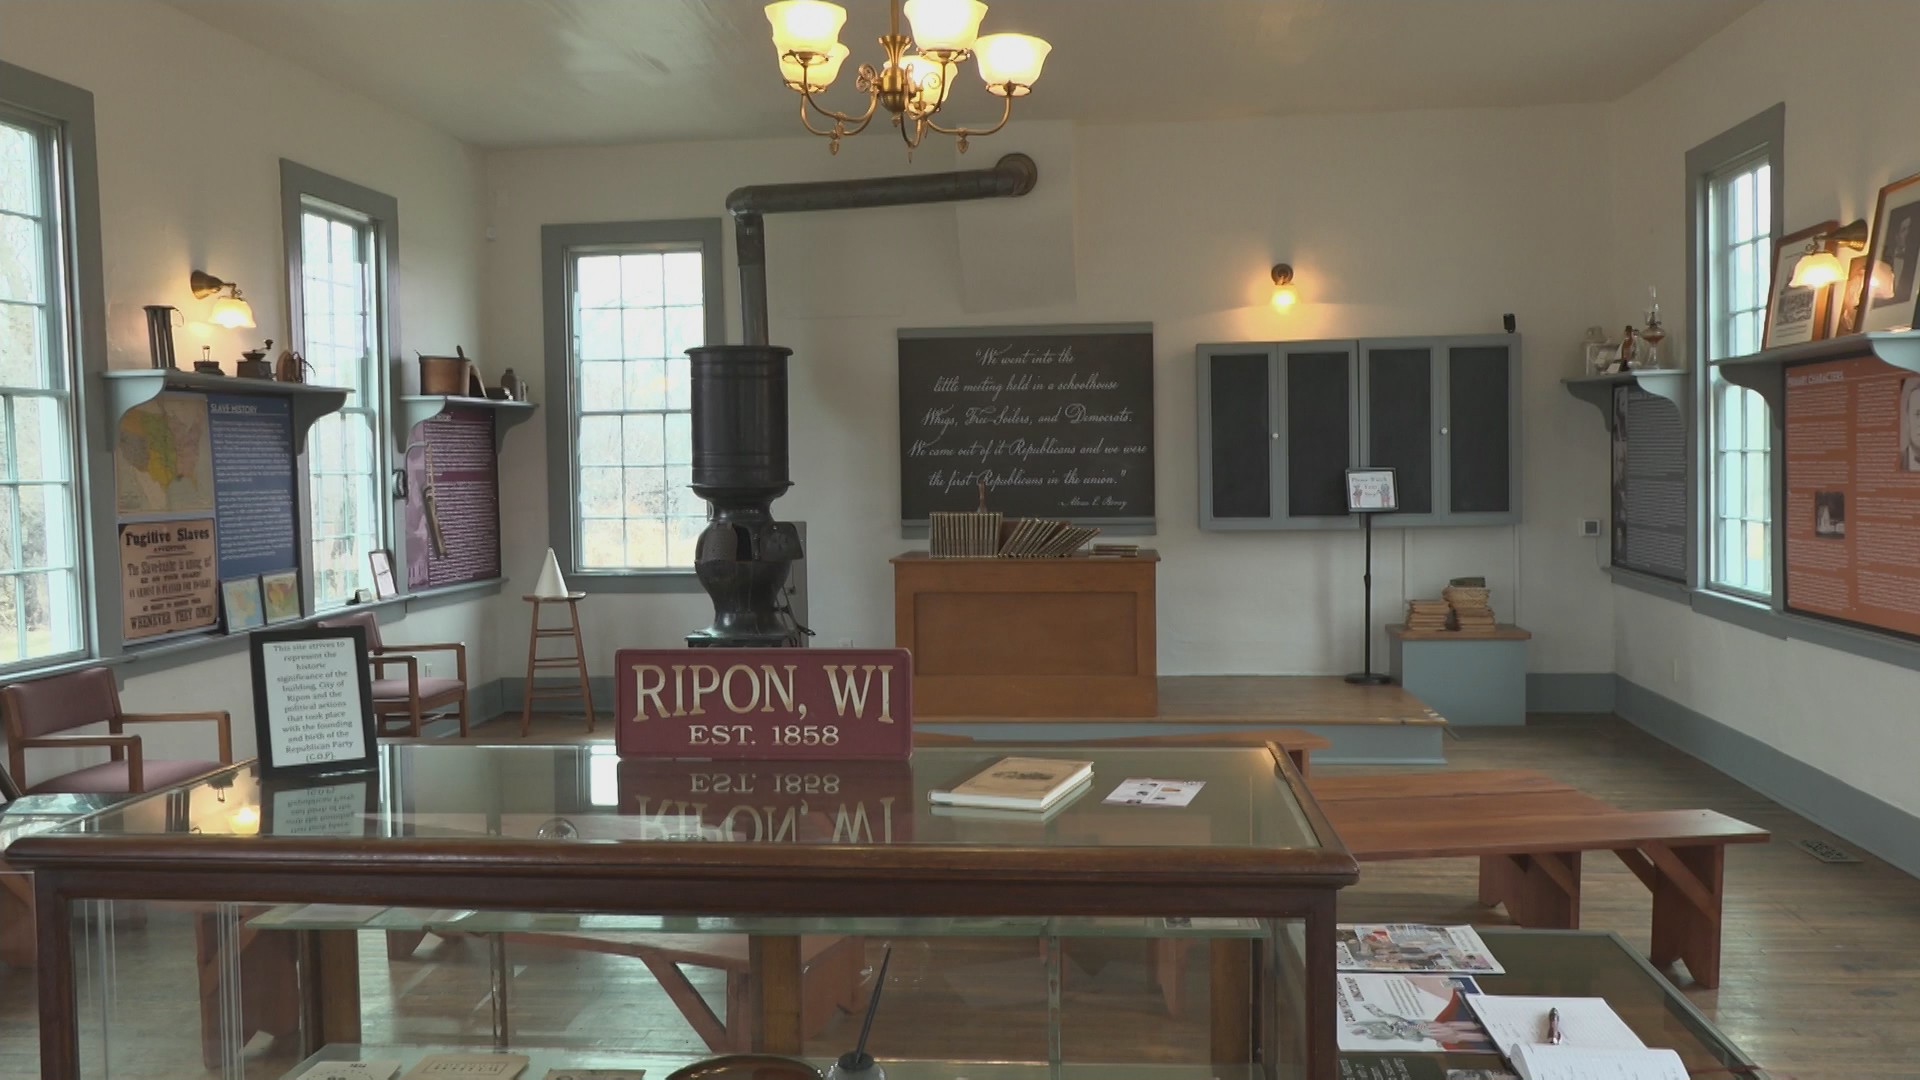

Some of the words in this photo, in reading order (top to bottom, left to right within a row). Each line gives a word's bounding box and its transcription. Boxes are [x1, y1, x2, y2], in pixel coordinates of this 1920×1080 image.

[1001, 349, 1036, 364] went
[1031, 349, 1056, 364] into
[1058, 345, 1075, 364] the
[933, 375, 960, 392] little
[963, 376, 1002, 402] meeting
[1006, 373, 1033, 391] held
[1032, 375, 1044, 390] in
[1047, 382, 1055, 390] a
[1057, 371, 1119, 390] schoolhouse
[921, 404, 959, 437] Whigs,
[964, 405, 1033, 426] Free-Soilers,
[1038, 406, 1062, 423] and
[928, 448, 954, 456] came
[957, 441, 984, 456] out
[979, 440, 994, 464] of
[993, 440, 1010, 456] it
[1008, 436, 1076, 462] Republicans
[1079, 437, 1105, 454] and
[1104, 446, 1119, 454] we
[1122, 445, 1147, 455] were
[928, 470, 946, 486] the
[944, 470, 976, 494] first
[976, 467, 1044, 492] Republicans
[1046, 470, 1060, 485] in
[1063, 467, 1081, 485] the
[125, 529, 171, 548] Fugitive
[177, 527, 210, 542] Slaves
[273, 644, 292, 653] This
[292, 643, 307, 651] site
[309, 641, 336, 650] strives
[336, 640, 346, 648] to
[283, 653, 322, 663] represent
[323, 651, 337, 659] the
[295, 662, 327, 671] historic
[276, 673, 324, 684] significance
[325, 671, 334, 679] of
[335, 669, 348, 678] the
[318, 681, 335, 690] City
[336, 680, 345, 688] of
[286, 693, 311, 702] Ripon
[313, 691, 328, 700] and
[329, 690, 343, 699] the
[631, 664, 808, 722] RIPON,
[823, 664, 895, 724] WI
[284, 703, 317, 714] political
[318, 701, 347, 710] actions
[287, 714, 304, 722] that
[304, 711, 323, 720] took
[325, 710, 346, 720] place
[281, 724, 301, 732] with
[302, 723, 316, 731] the
[317, 720, 353, 730] founding
[287, 734, 304, 743] and
[304, 732, 325, 741] birth
[326, 730, 335, 739] of
[336, 729, 349, 738] the
[688, 724, 756, 747] EST.
[772, 724, 840, 747] 1858
[285, 743, 331, 754] Republican
[332, 740, 354, 749] Party
